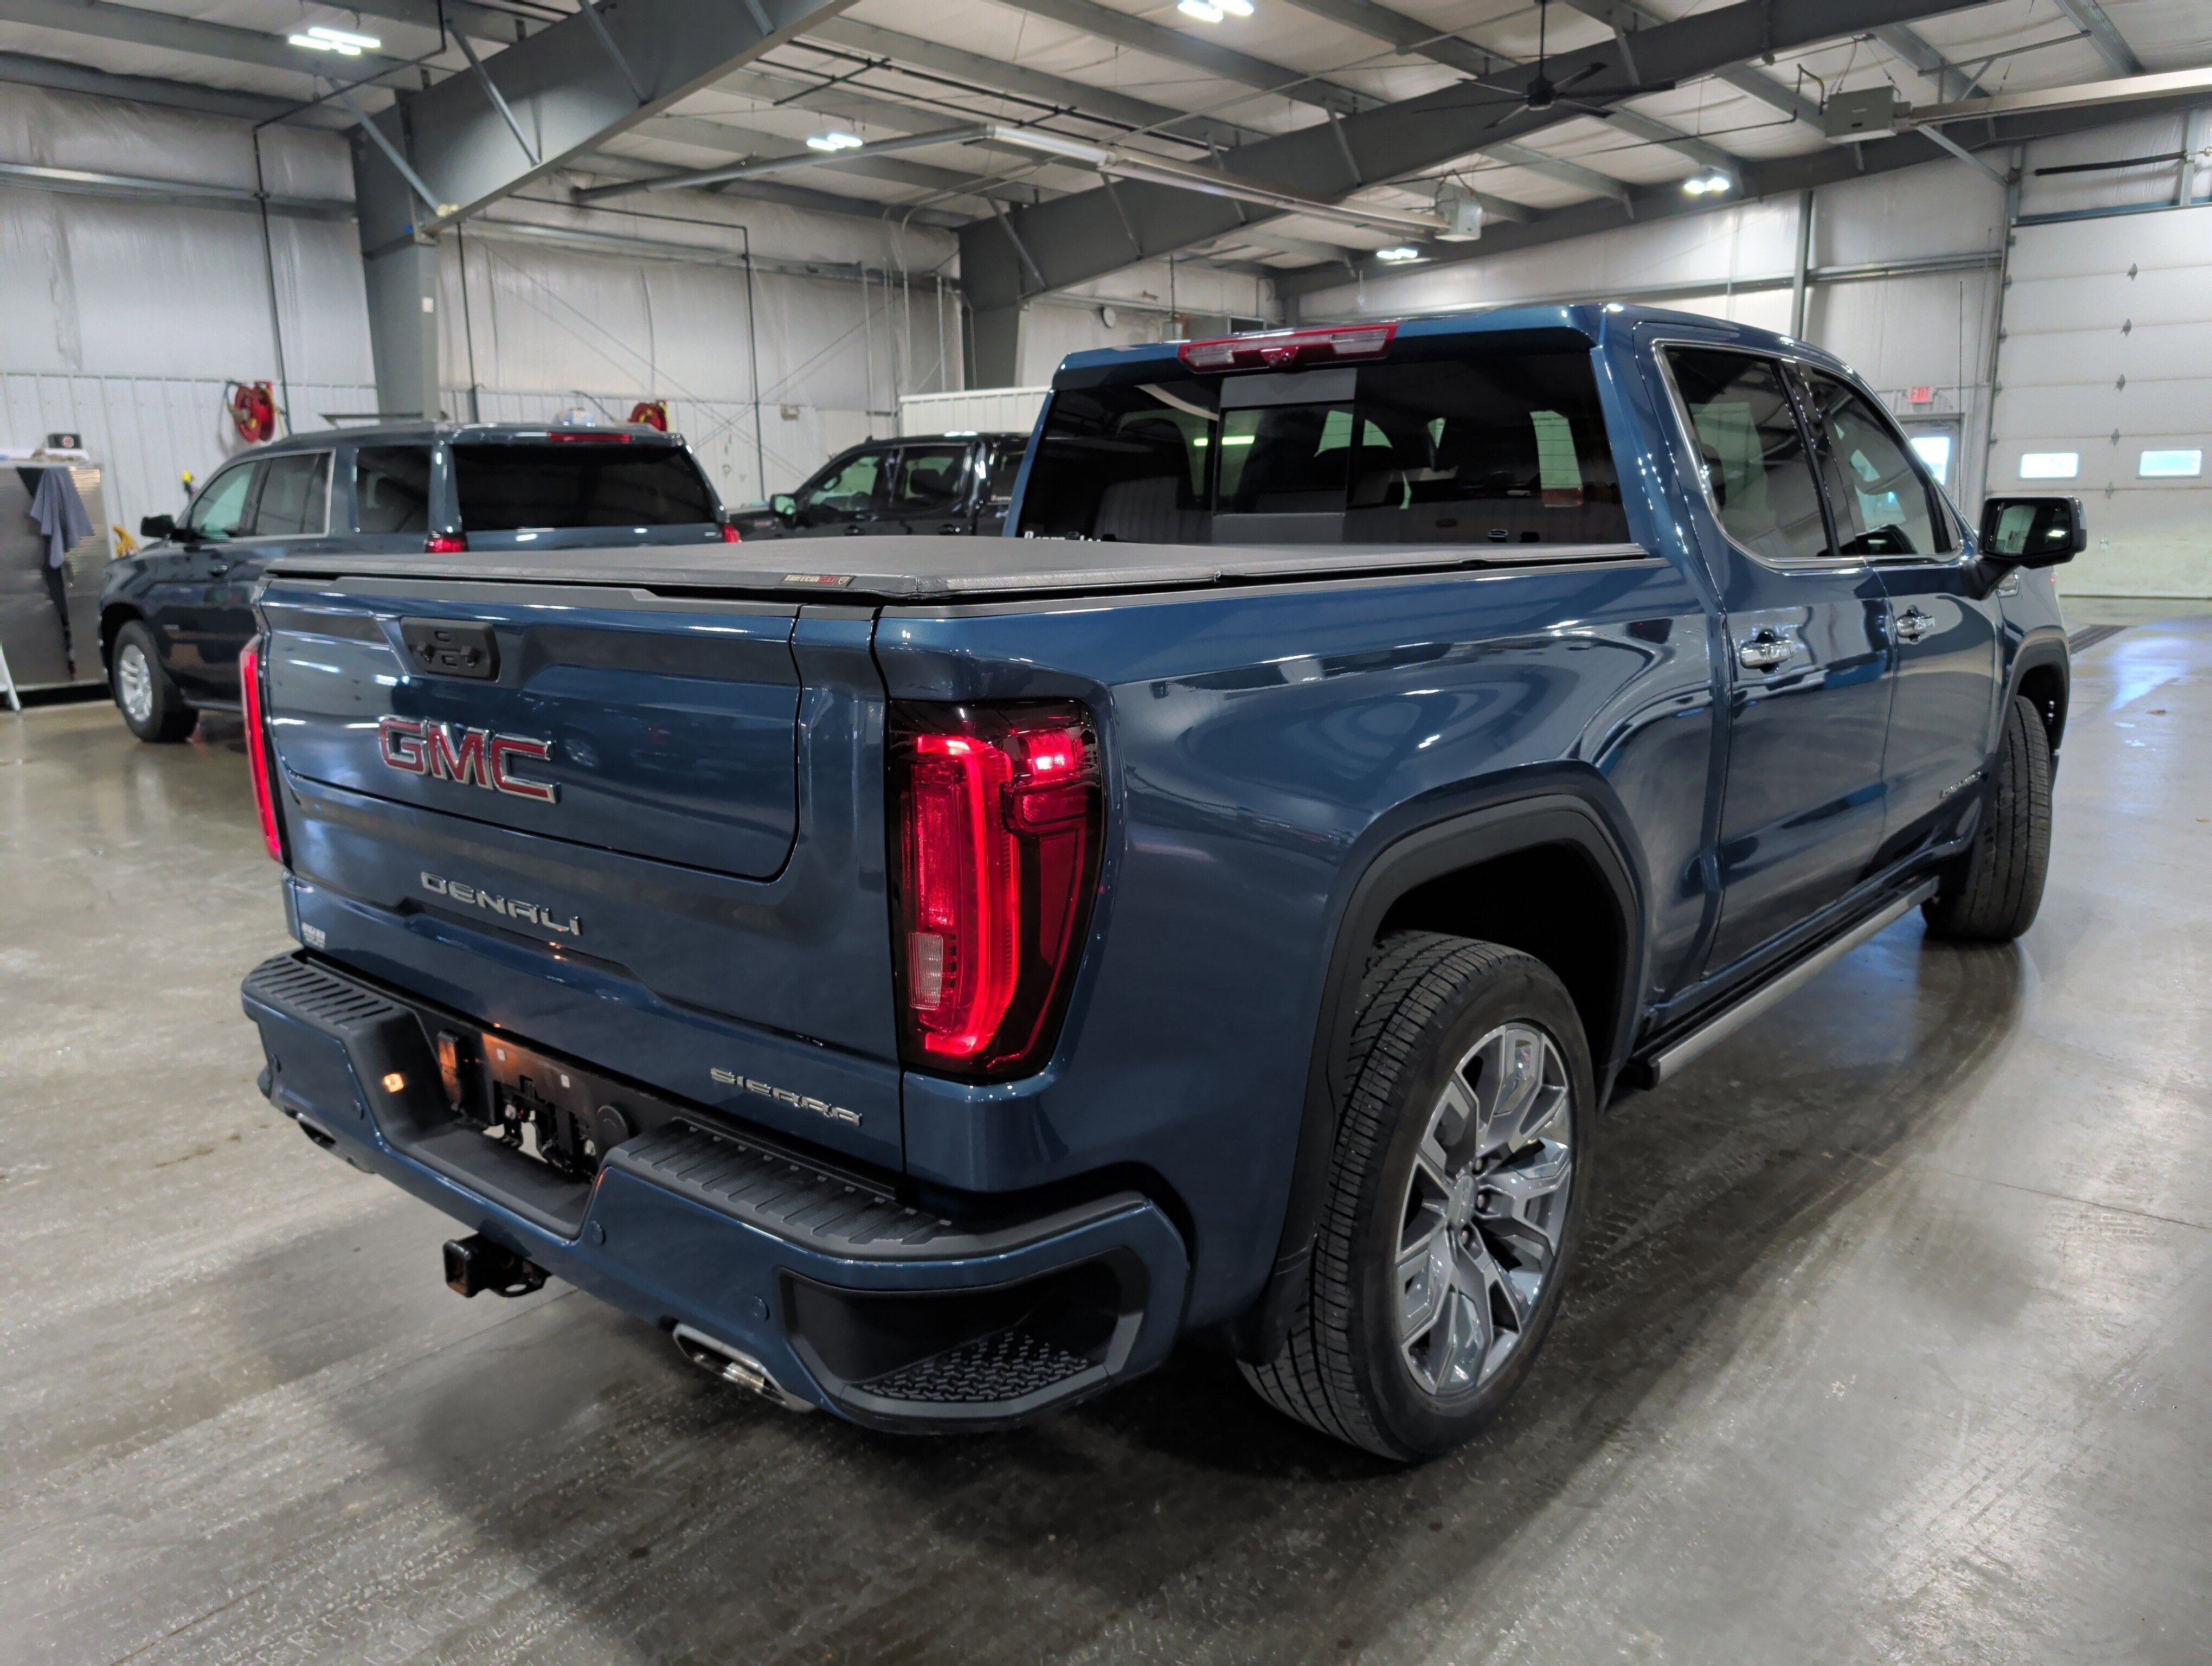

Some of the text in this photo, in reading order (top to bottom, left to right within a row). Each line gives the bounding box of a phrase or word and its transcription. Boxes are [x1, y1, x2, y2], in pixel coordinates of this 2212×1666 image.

[1911, 387, 1930, 401] EXIT
[379, 714, 561, 804] GMC
[421, 871, 581, 937] DENALI
[710, 1067, 861, 1126] SIERRA
